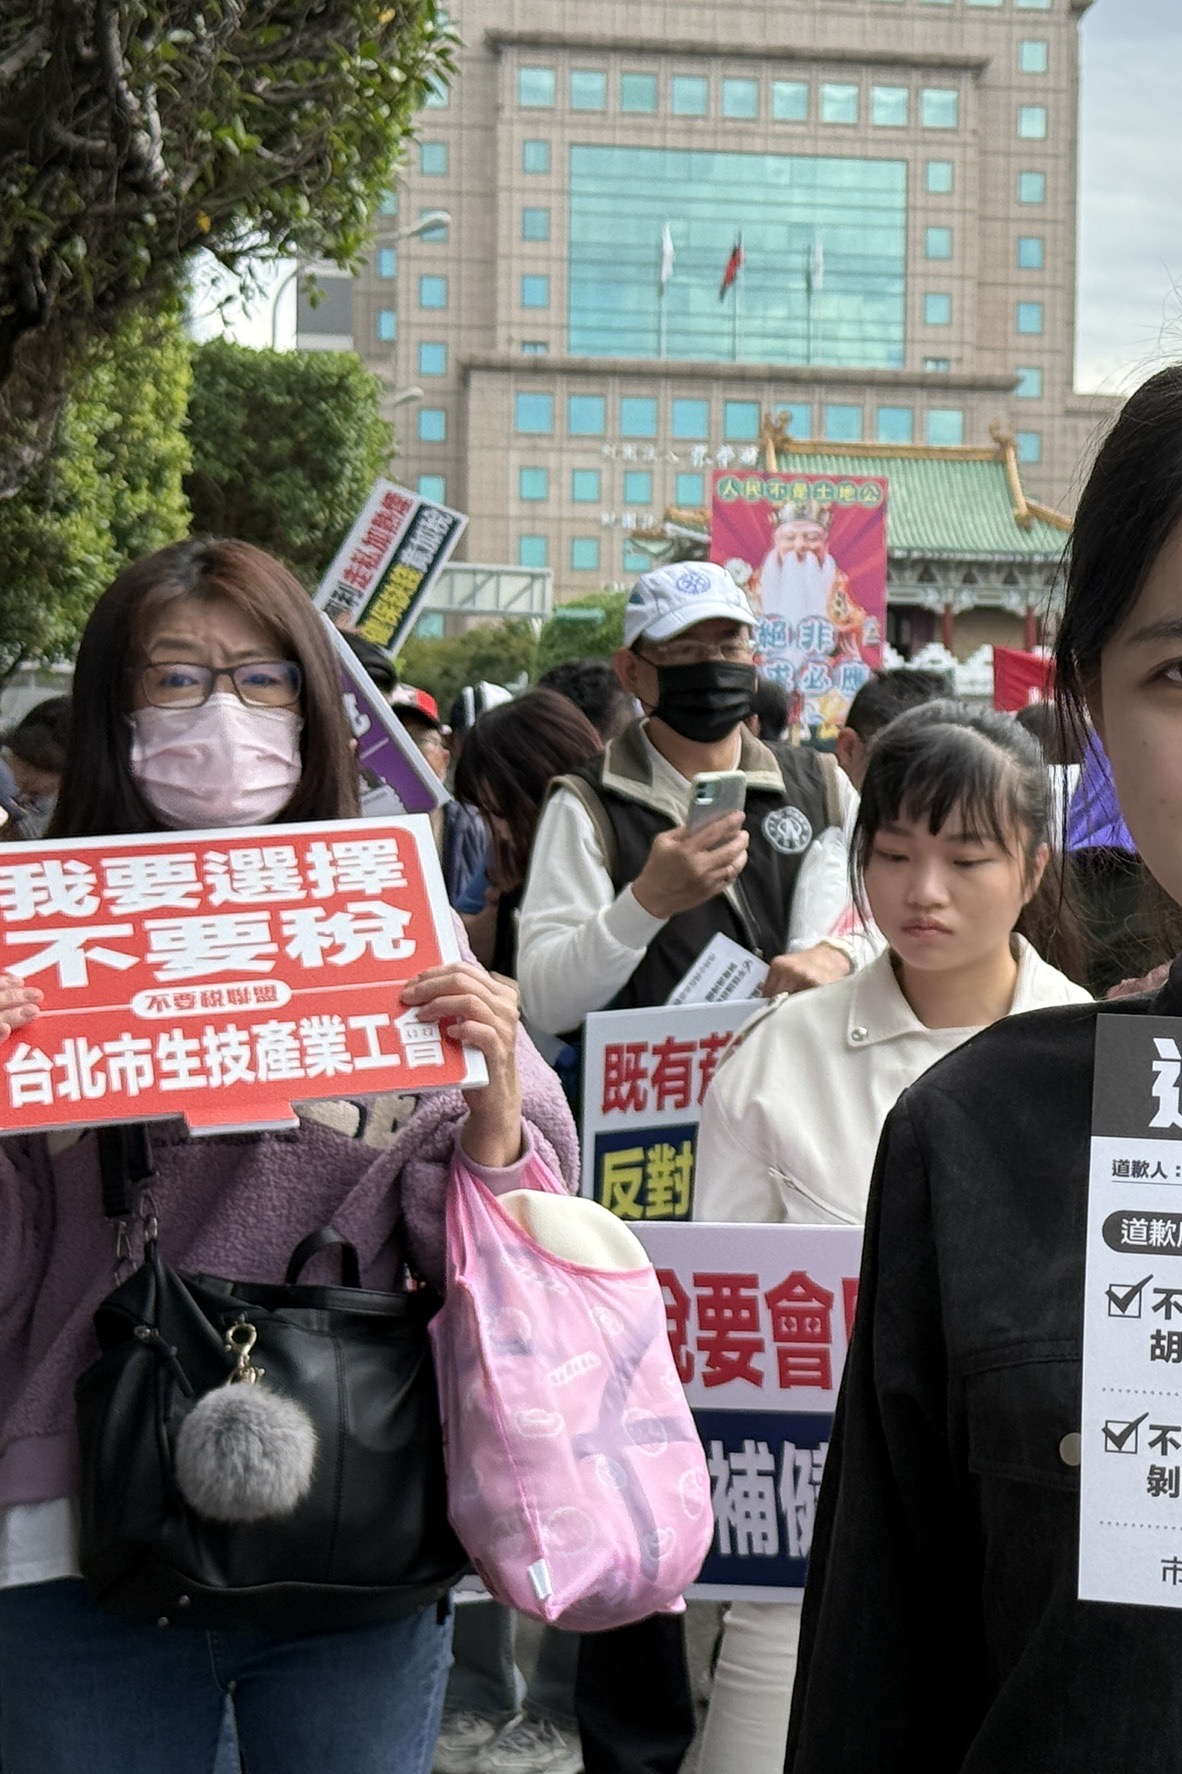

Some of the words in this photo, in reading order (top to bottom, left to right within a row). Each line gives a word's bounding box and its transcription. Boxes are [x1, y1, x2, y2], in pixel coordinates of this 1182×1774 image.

[720, 477, 880, 504] 人民不是土地公
[758, 622, 833, 651] 絕非
[0, 838, 408, 922] 我要選擇
[5, 900, 416, 989] 不要稅
[146, 984, 278, 1013] 不要稅聯盟
[5, 1012, 445, 1107] 台北市生技產業工會
[602, 1140, 694, 1219] 反對
